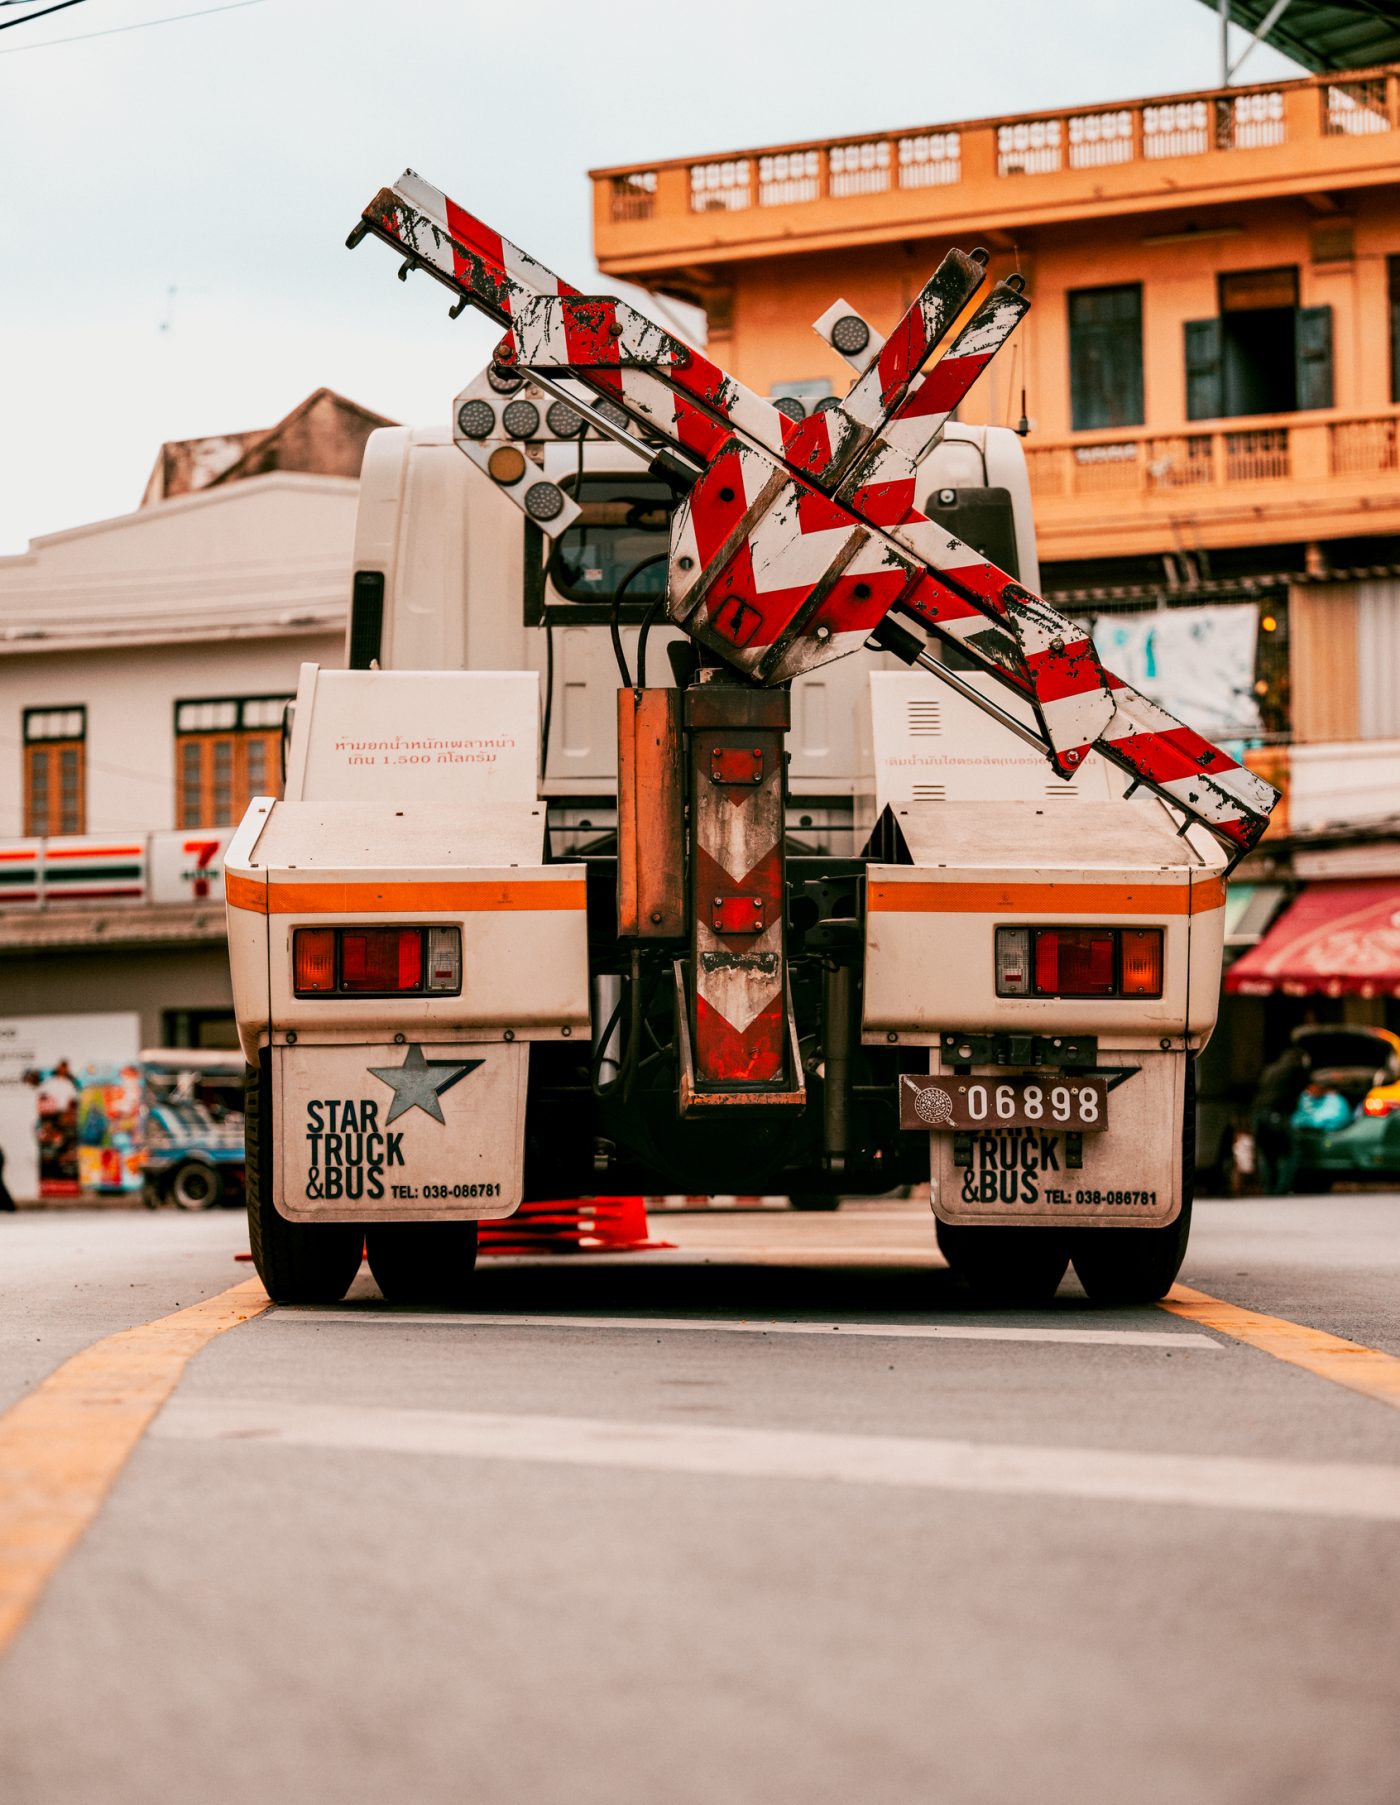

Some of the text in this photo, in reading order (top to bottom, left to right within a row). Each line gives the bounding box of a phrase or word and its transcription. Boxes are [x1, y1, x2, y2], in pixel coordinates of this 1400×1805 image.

[335, 734, 516, 750] ห้ามยกน้ำหนักเพลาหน้า
[348, 751, 499, 765] เกิน 1.500 กิโลกรัม
[307, 1100, 378, 1133] STAR
[968, 1085, 1098, 1123] 06898
[306, 1132, 405, 1167] TRUCK
[306, 1166, 500, 1200] &BUS TEL: 038-086781
[961, 1169, 1157, 1205] &BUS TEL: 038-086781
